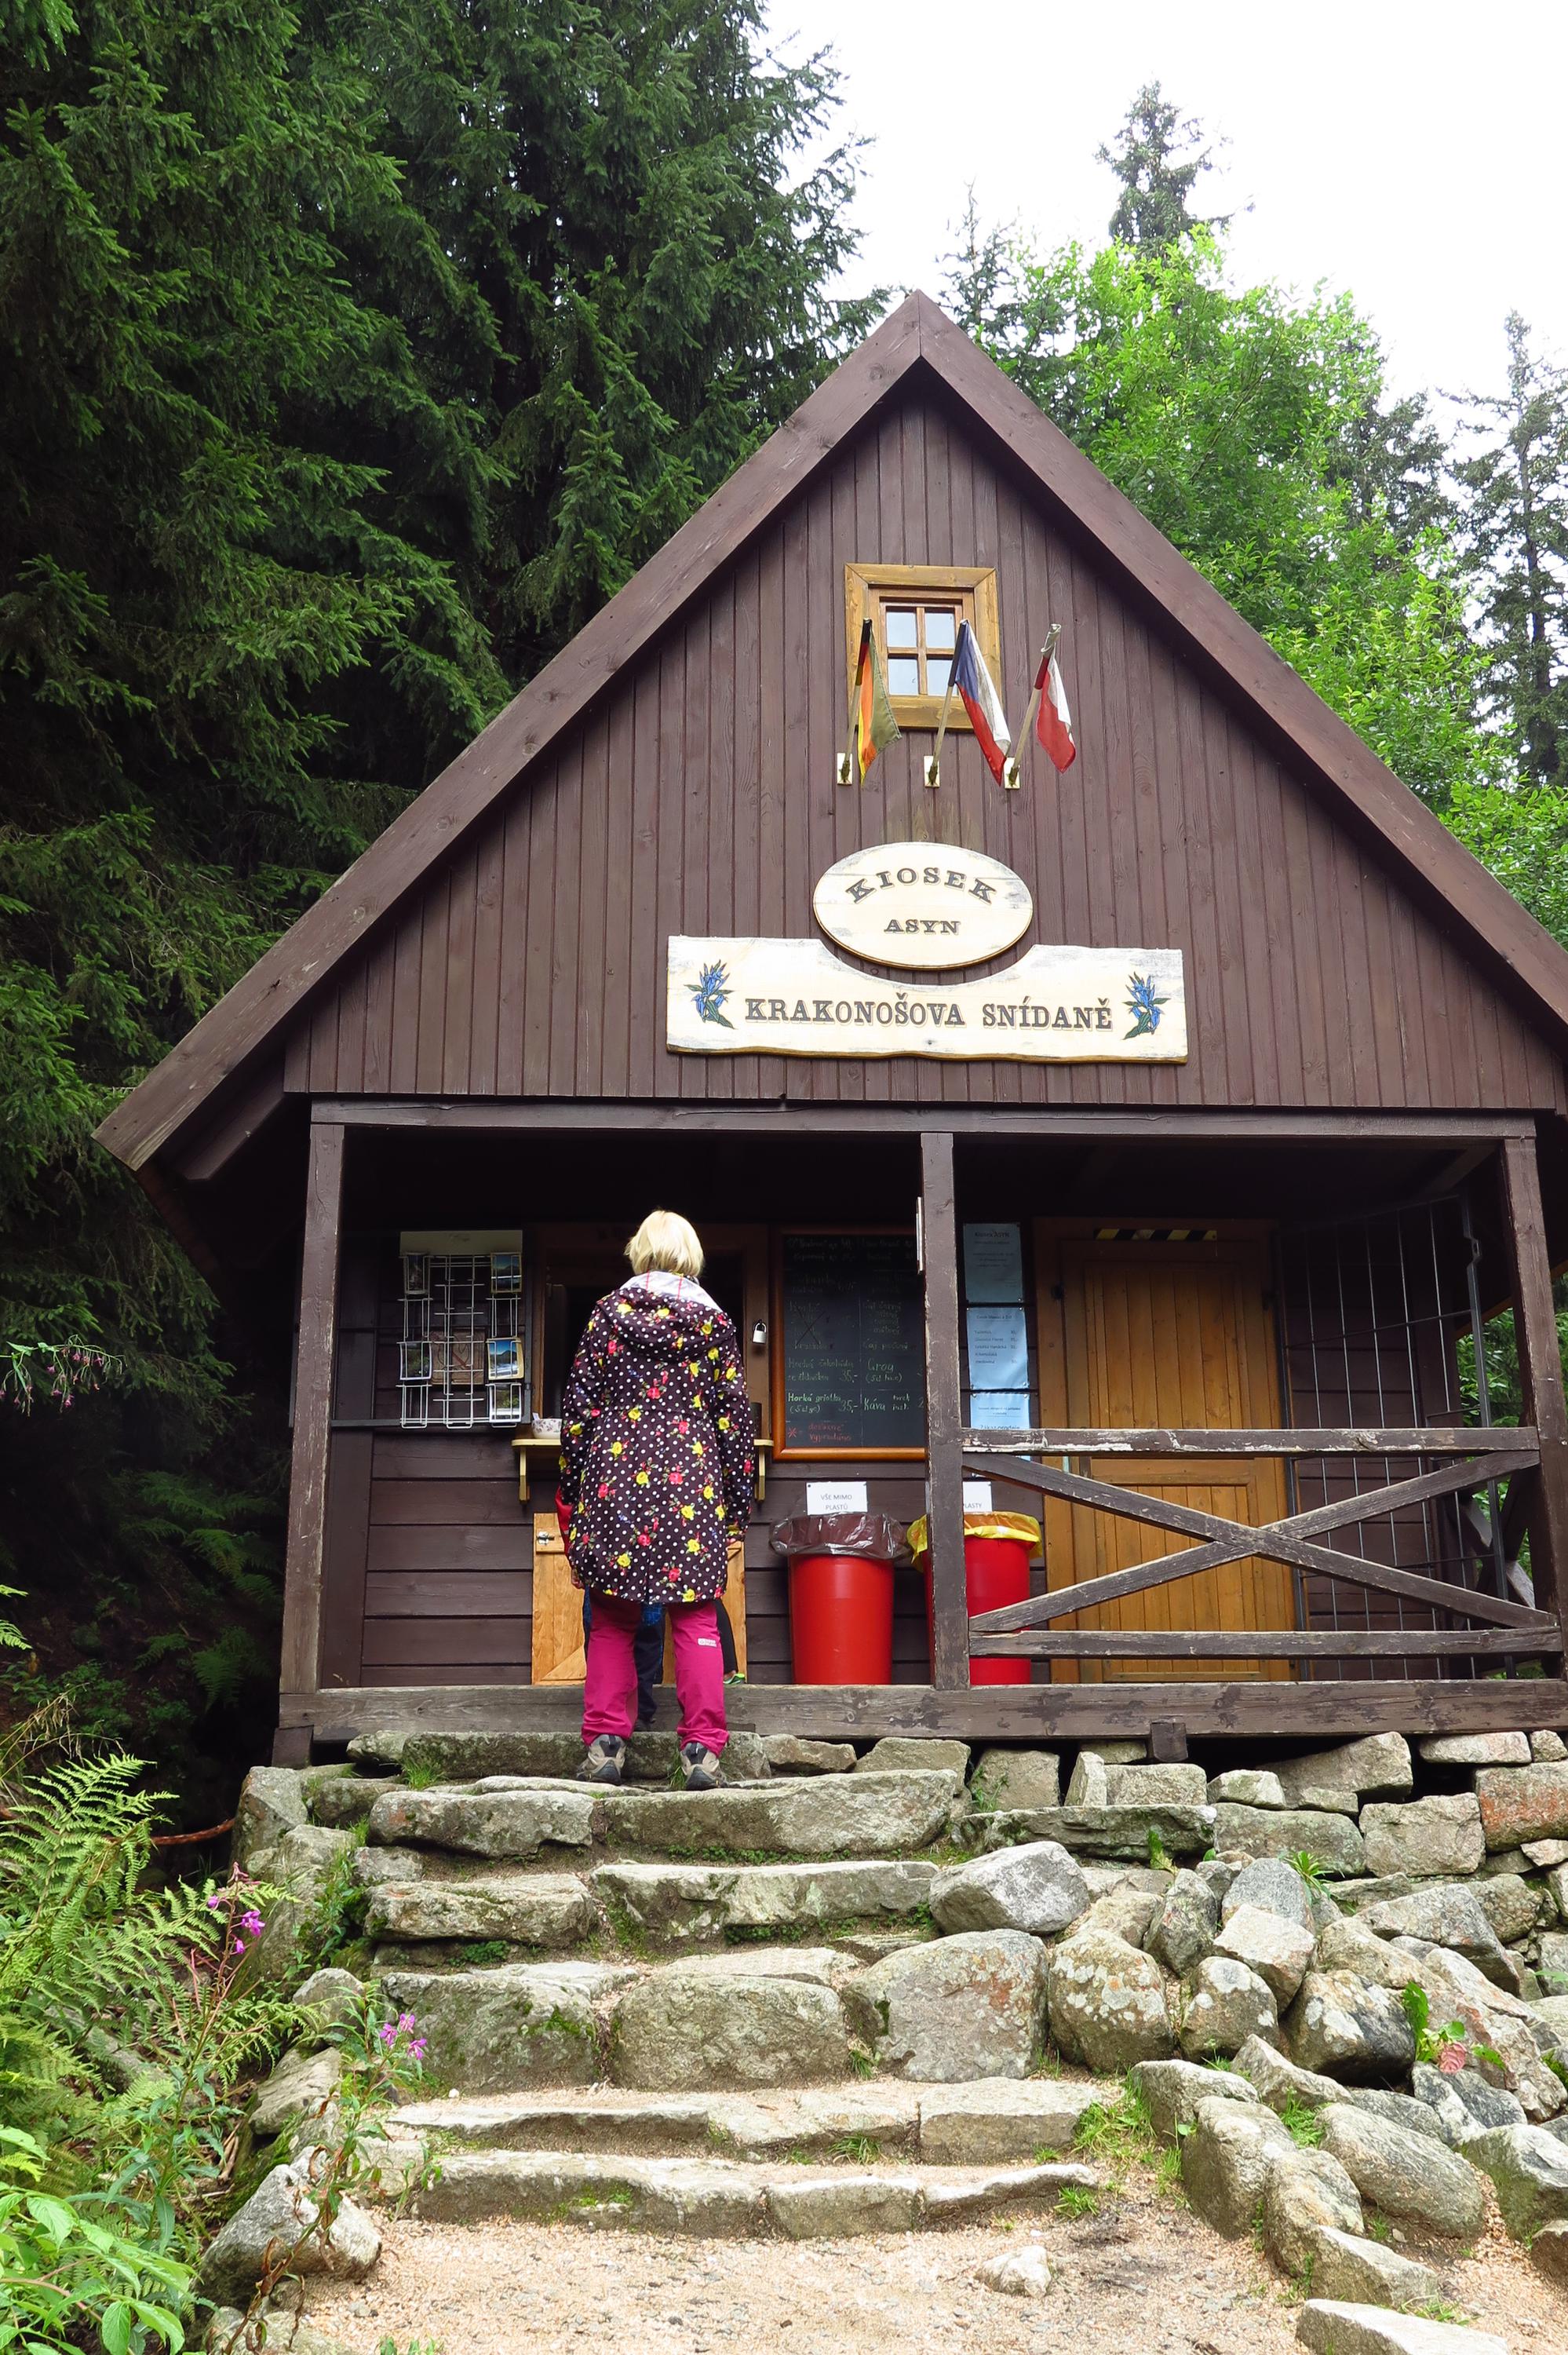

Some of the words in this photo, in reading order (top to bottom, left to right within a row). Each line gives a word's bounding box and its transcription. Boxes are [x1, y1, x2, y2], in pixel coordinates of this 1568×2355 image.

[844, 867, 998, 905] KIOSEK
[884, 919, 961, 936] ASYN
[745, 992, 965, 1028] KRAKONOŠOVA
[982, 996, 1112, 1031] SNÍDANĚ
[867, 1357, 895, 1373] Grog
[788, 1392, 813, 1402] Horká
[864, 1397, 886, 1411] Káva
[826, 1502, 848, 1511] PLASTŮ
